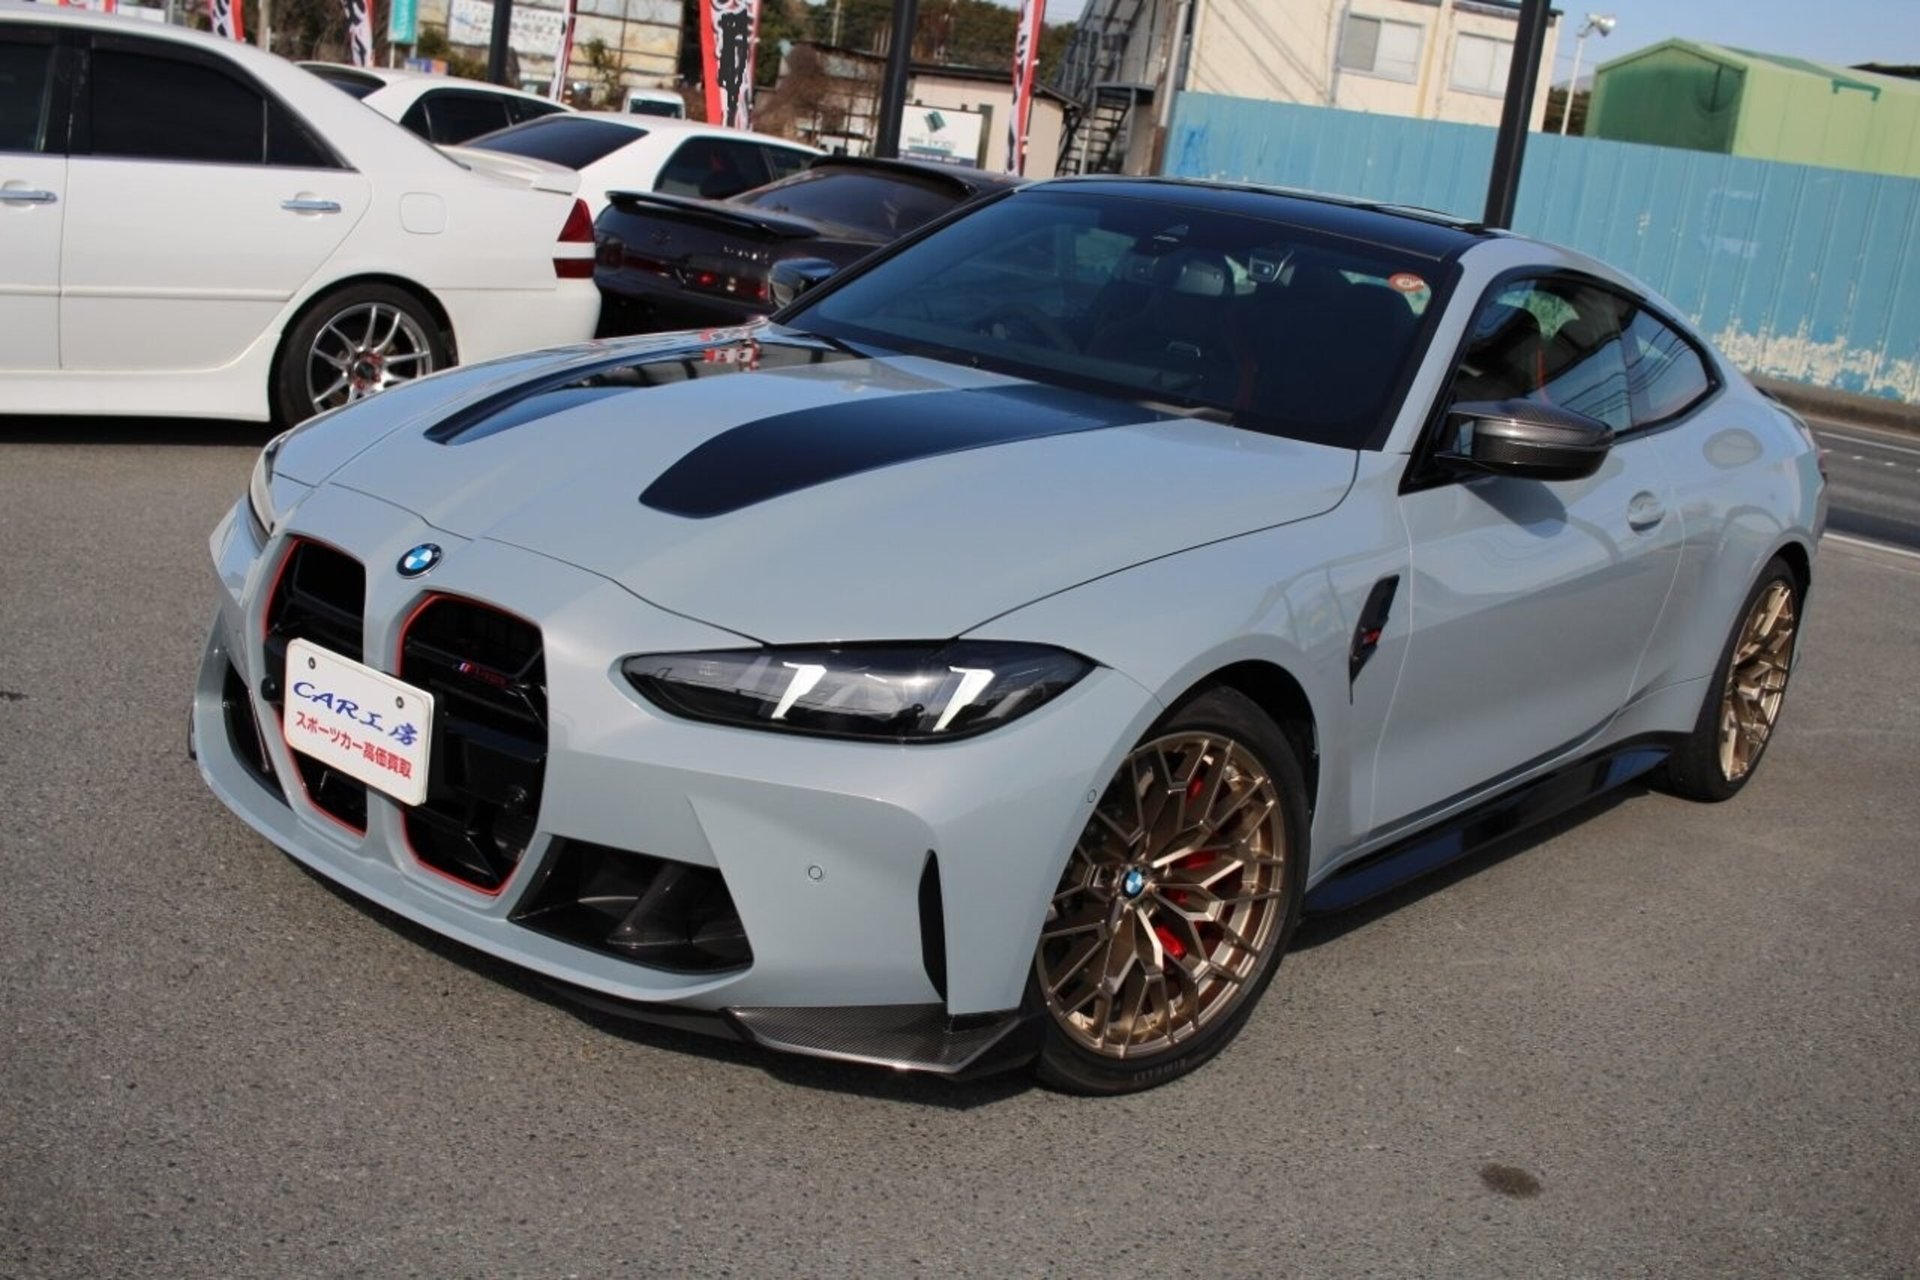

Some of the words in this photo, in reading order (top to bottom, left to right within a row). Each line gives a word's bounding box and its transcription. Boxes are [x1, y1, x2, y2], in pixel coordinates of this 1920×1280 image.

[293, 681, 418, 746] CAR工房
[296, 711, 412, 780] スポーツカー高価買取
